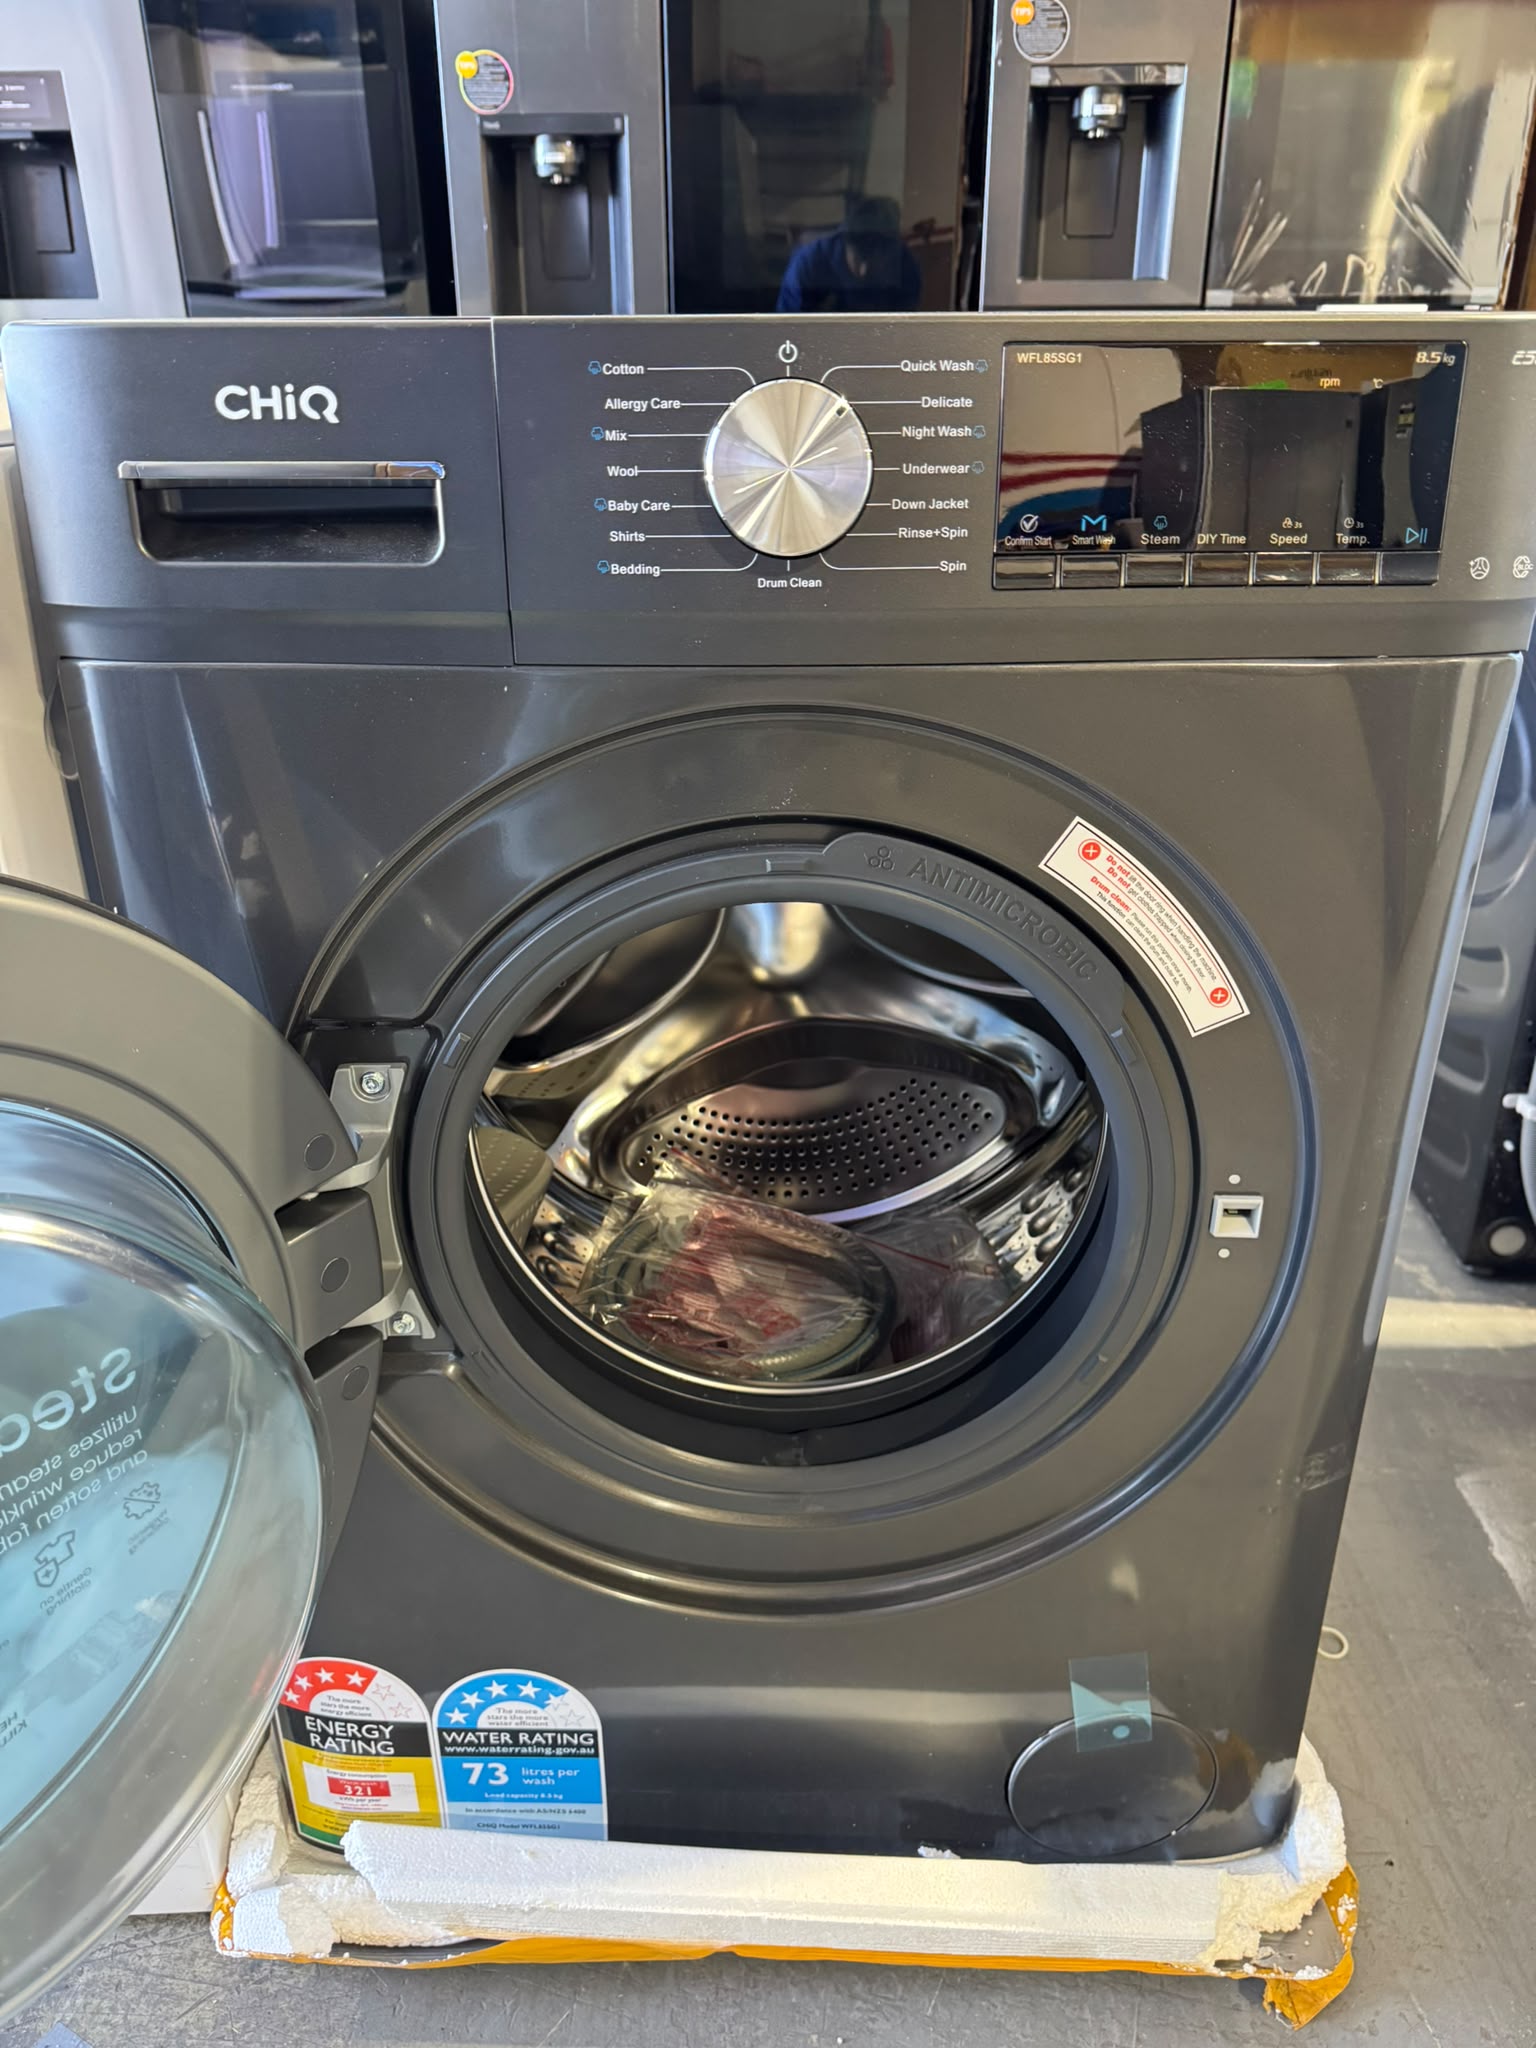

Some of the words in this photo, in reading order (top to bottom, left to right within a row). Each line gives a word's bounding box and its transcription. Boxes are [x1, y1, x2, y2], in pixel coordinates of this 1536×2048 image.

[1016, 352, 1082, 364] WFL85SG1
[602, 363, 645, 375] Cotton
[900, 359, 937, 374] Quick
[939, 359, 975, 371] Wash
[1320, 378, 1340, 389] rpm
[215, 383, 340, 424] CHiQ
[604, 398, 648, 412] Allergy
[650, 397, 681, 409] Care
[921, 396, 973, 408] Delicate
[605, 429, 627, 441] Mix
[902, 425, 935, 440] Night
[937, 425, 972, 437] Wash
[607, 465, 638, 477] Wool
[902, 463, 970, 475] Underwear
[608, 500, 639, 514] Baby
[641, 499, 671, 511] Care
[892, 498, 926, 510] Down
[928, 498, 969, 509] Jacket
[609, 530, 646, 542] Shirts
[898, 526, 968, 540] Rinse+Spin
[1197, 534, 1217, 544] DIY
[1220, 534, 1247, 544] Time
[1004, 535, 1034, 546] Confirm
[1034, 535, 1052, 546] Start
[1072, 535, 1095, 545] Smart
[1140, 534, 1180, 545] Steam
[1269, 534, 1308, 547] Speed
[1336, 534, 1370, 547] Temp.
[610, 563, 661, 577] Bedding
[939, 560, 967, 574] Spin
[757, 577, 788, 588] Drum
[789, 577, 822, 588] Clean
[1106, 855, 1117, 866] Do
[1117, 865, 1131, 877] not
[1107, 867, 1118, 878] Do
[1117, 877, 1131, 889] not
[1090, 876, 1111, 894] Drum
[1110, 892, 1132, 913] clean:
[1097, 891, 1107, 902] This
[906, 856, 1098, 980] ANTIMICROBIC
[305, 1715, 394, 1739] ENERGY
[310, 1733, 395, 1755] RATING
[442, 1731, 513, 1744] WATER
[519, 1732, 594, 1745] RATING
[444, 1745, 595, 1755] www.waterrating.gov.au
[461, 1762, 510, 1786] 73
[521, 1767, 554, 1776] litres
[557, 1768, 580, 1779] per
[522, 1777, 555, 1785] wash
[344, 1785, 372, 1796] 321
